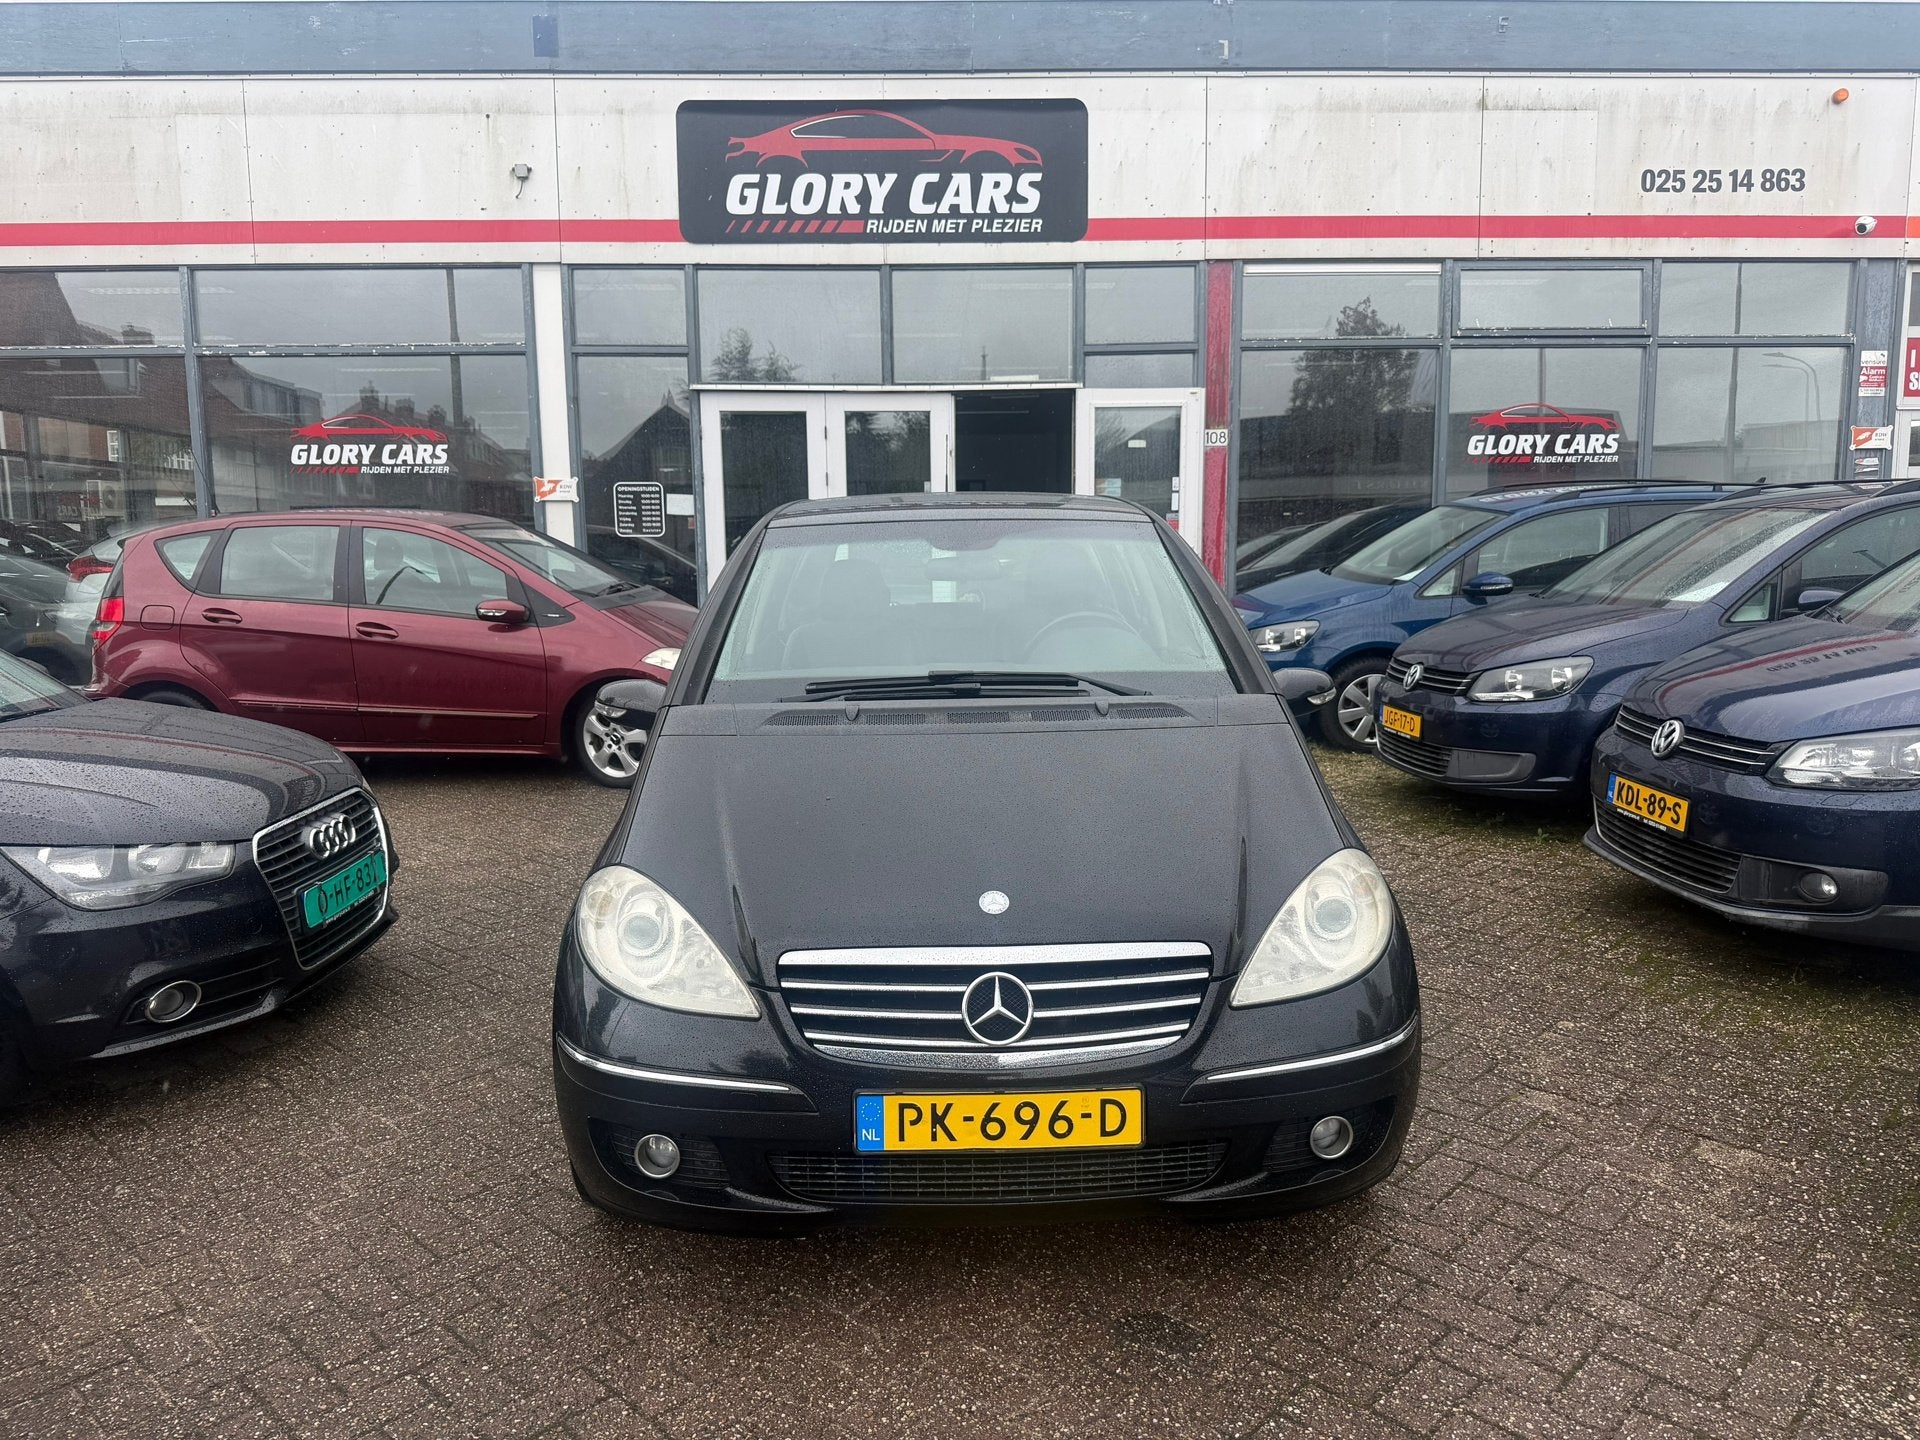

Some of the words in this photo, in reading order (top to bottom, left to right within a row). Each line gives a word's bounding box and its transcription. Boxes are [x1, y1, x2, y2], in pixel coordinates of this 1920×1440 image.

[1640, 168, 1686, 193] 025
[1691, 168, 1723, 193] 25
[1728, 168, 1755, 193] 14
[1760, 167, 1806, 192] 863
[725, 172, 898, 215] GLORY
[908, 172, 1043, 215] CARS
[866, 219, 930, 234] RIJDEN
[931, 219, 969, 233] MET
[971, 218, 1043, 233] PLEZIER
[1860, 366, 1886, 375] Alarm
[1908, 371, 1920, 391] S
[1206, 431, 1227, 444] 108
[1467, 434, 1551, 455] GLORY
[1554, 433, 1619, 454] CARS
[290, 444, 376, 465] GLORY
[381, 444, 449, 465] CARS
[1583, 455, 1619, 463] PLEZIER
[360, 466, 392, 474] RIJDEN
[393, 466, 412, 474] MET
[413, 466, 450, 474] PLEZIER
[1384, 709, 1416, 732] JGF-17-D
[1616, 780, 1682, 825] KDL-89-S
[897, 1097, 1128, 1142] PK-696-D
[861, 1128, 880, 1141] NL
